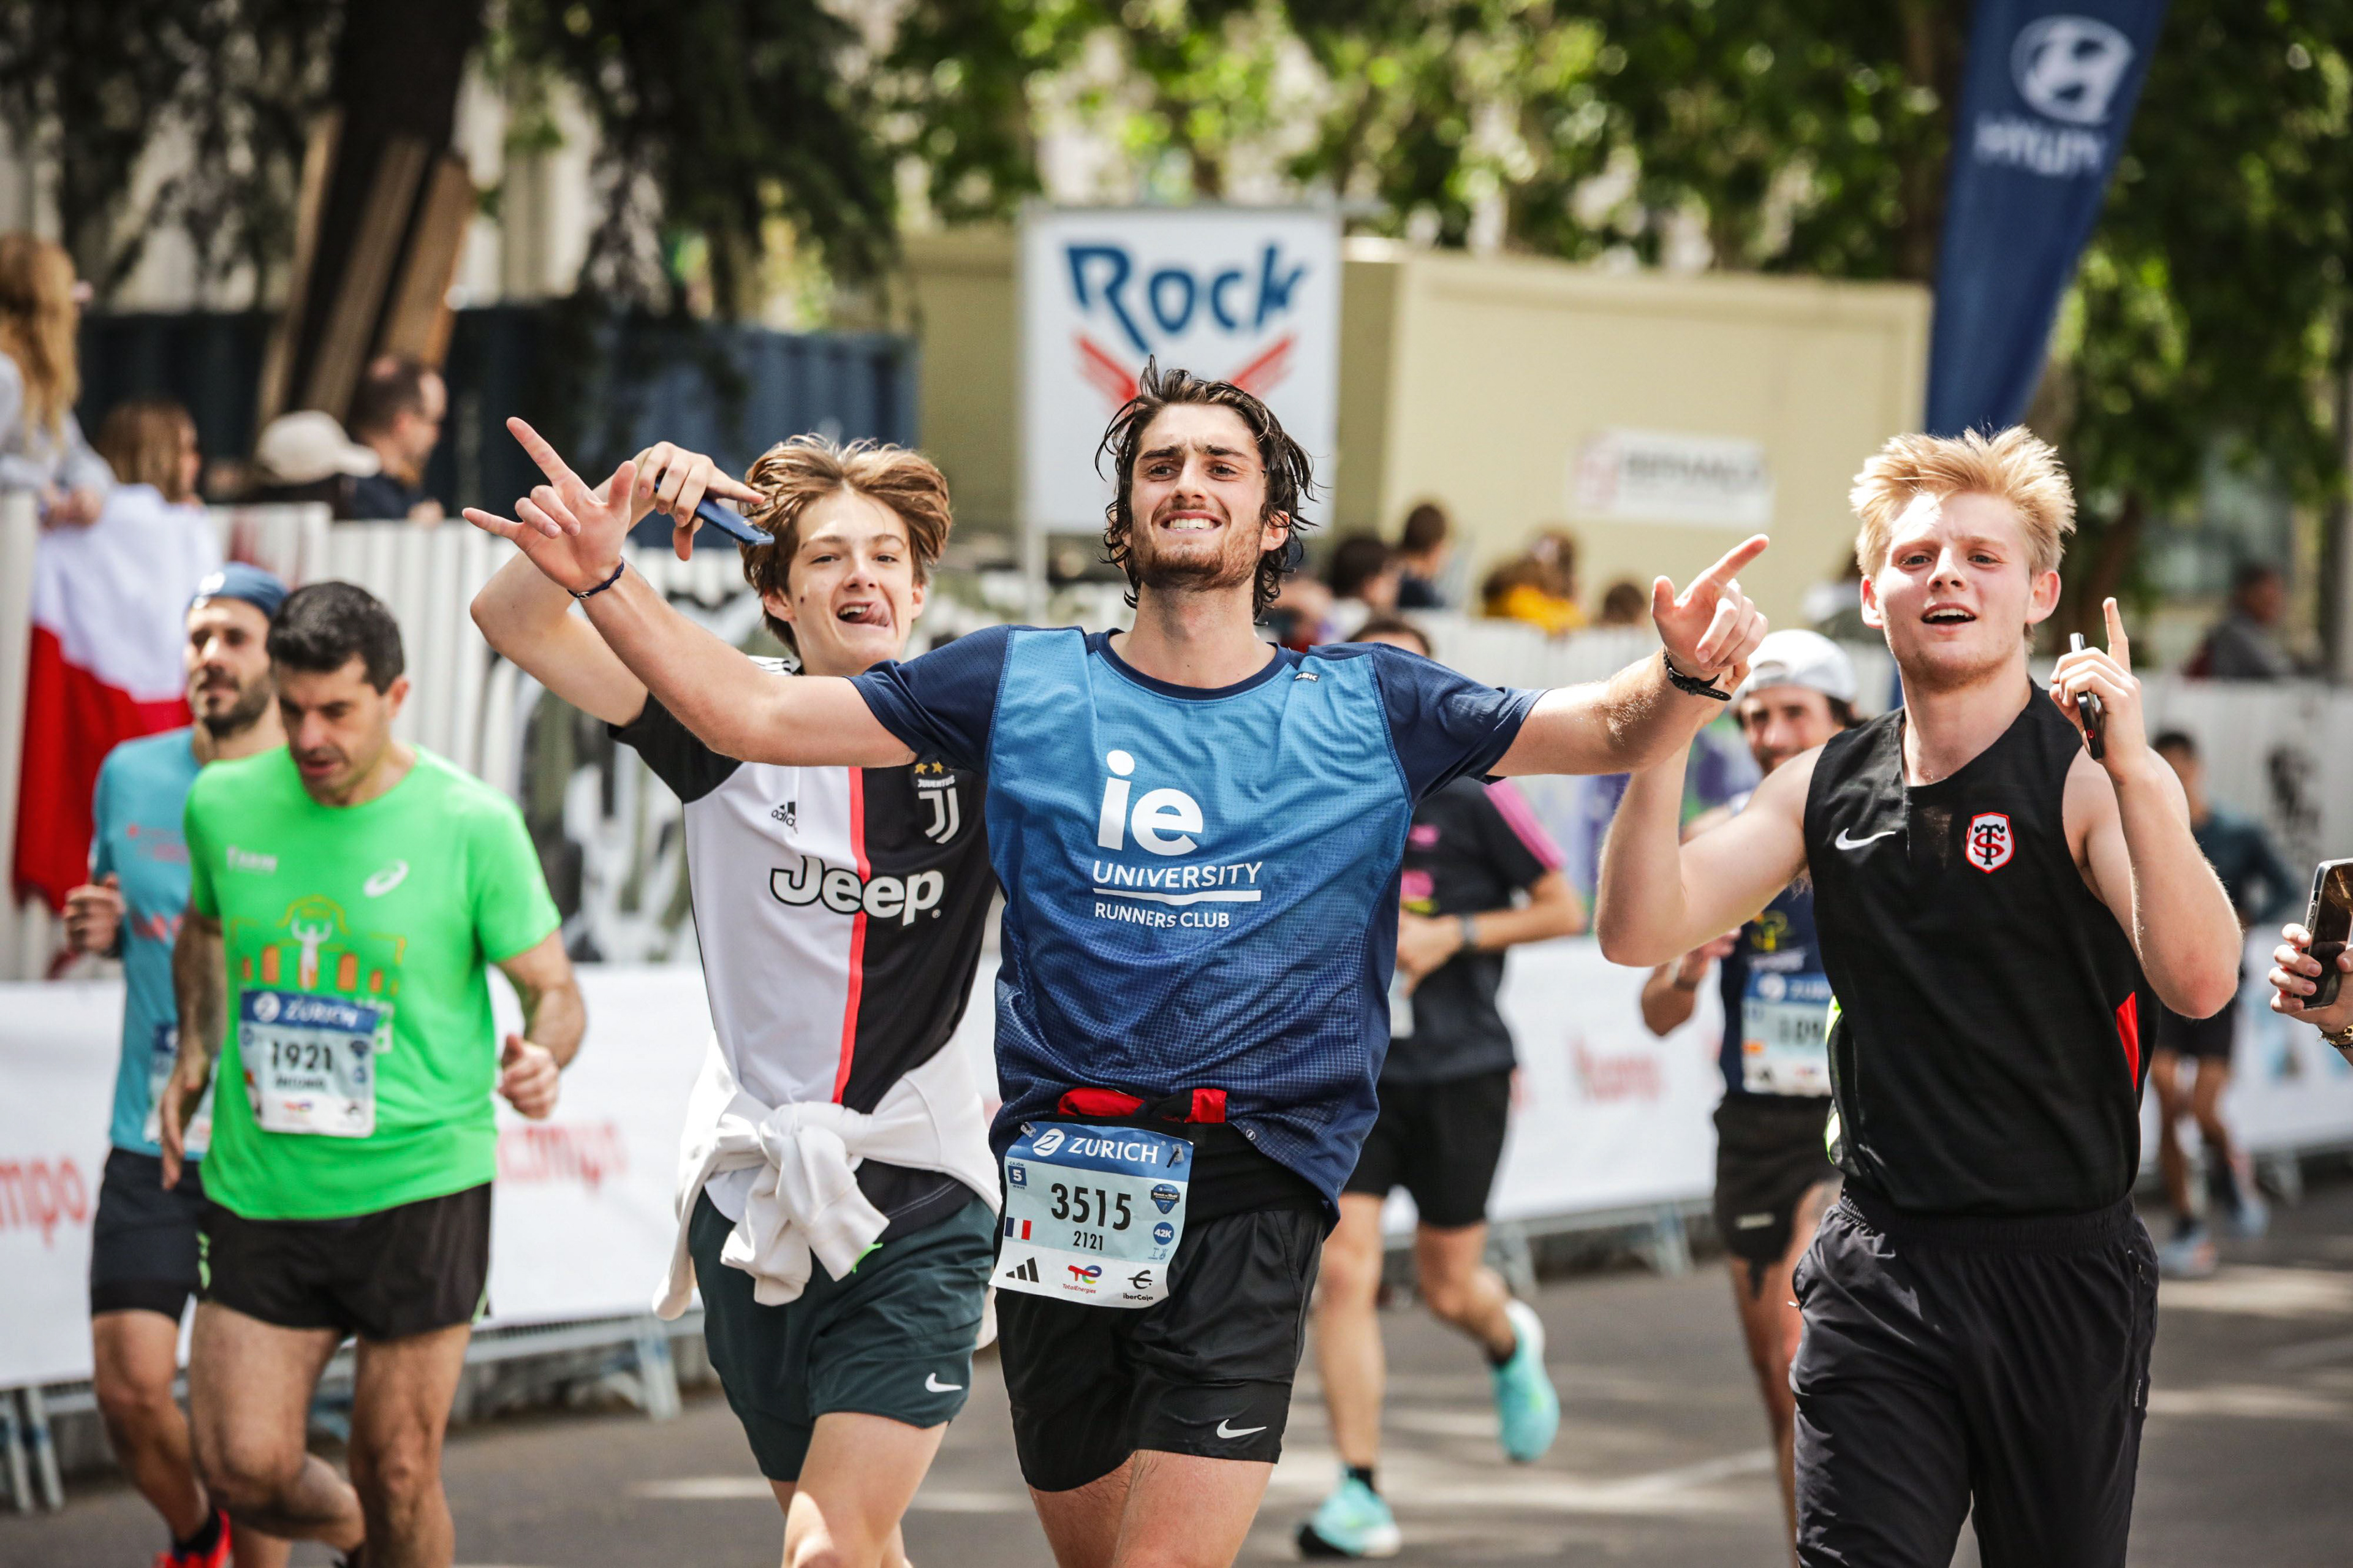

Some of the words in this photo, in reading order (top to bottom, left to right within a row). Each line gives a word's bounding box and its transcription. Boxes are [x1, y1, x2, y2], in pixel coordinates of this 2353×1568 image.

[1065, 240, 1309, 355] Rock
[918, 775, 955, 788] JUVENTUS
[1097, 750, 1203, 856] ie
[1093, 860, 1263, 888] UNIVERSITY
[770, 855, 944, 926] Jeep
[1094, 902, 1176, 928] RUNNERS
[1180, 912, 1230, 928] CLUB
[271, 1040, 332, 1070] 1921
[1067, 1137, 1159, 1164] ZURICH
[1013, 1168, 1023, 1182] 5
[1051, 1183, 1131, 1231] 3515
[1073, 1230, 1104, 1251] 2121
[1154, 1228, 1172, 1238] 42K
[1063, 1283, 1096, 1294] TotalEnergies
[1123, 1293, 1153, 1301] iberCaja
